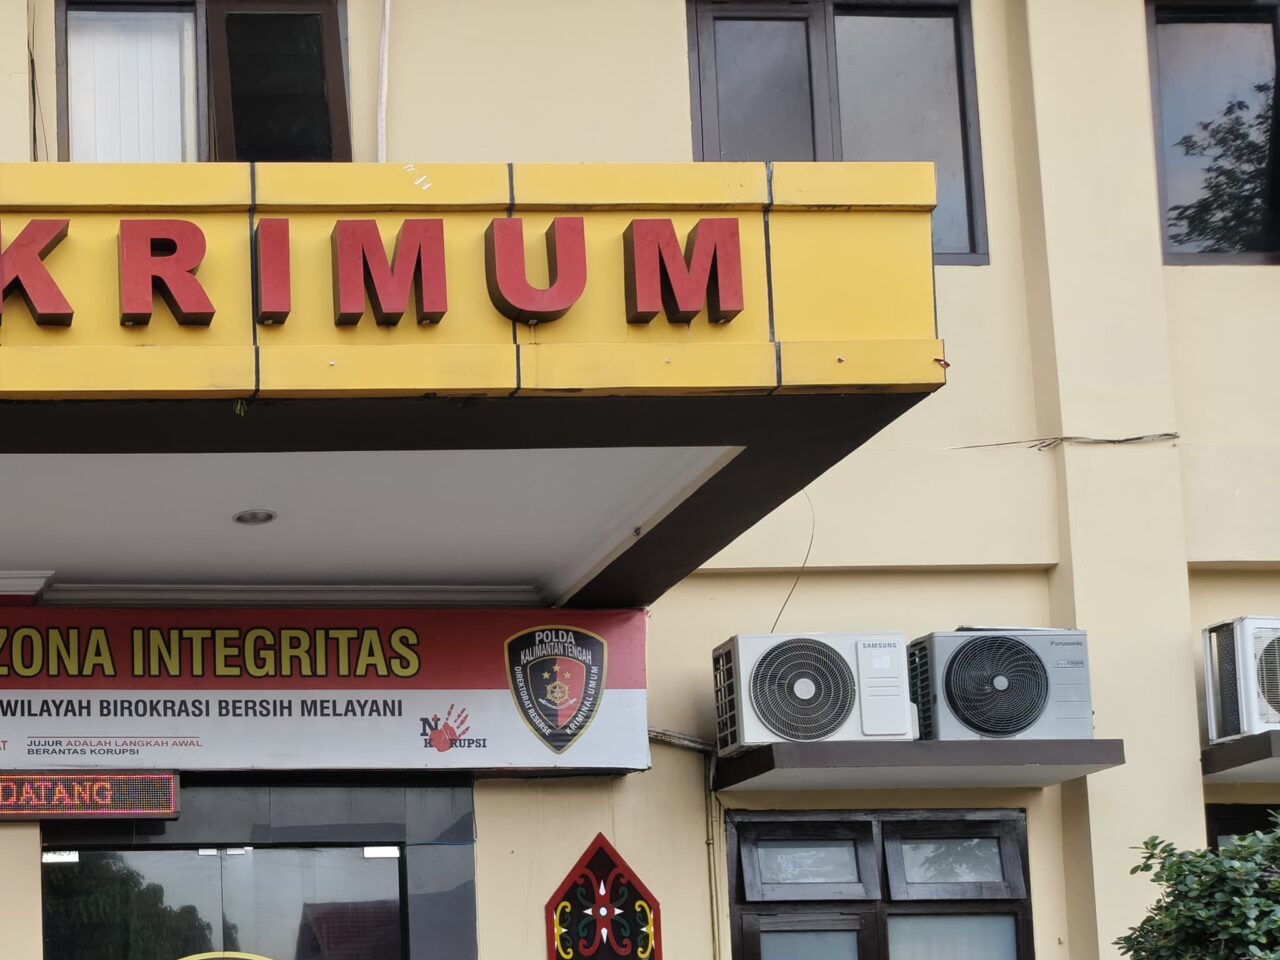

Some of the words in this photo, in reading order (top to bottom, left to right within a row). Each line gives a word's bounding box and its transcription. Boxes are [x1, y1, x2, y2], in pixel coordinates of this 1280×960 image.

[535, 630, 576, 645] POLDA
[131, 626, 421, 678] INTEGRITAS
[520, 642, 564, 665] KALIMANTAN
[565, 643, 592, 665] TENGAH
[0, 699, 91, 717] WILAYAH
[99, 699, 210, 717] BIROKRASI
[219, 699, 293, 718] BERSIH
[300, 699, 404, 718] MELAYANI
[514, 666, 533, 711] DIREKTORAT
[527, 707, 553, 736] RESERSE
[565, 696, 593, 735] KRIMINAL
[587, 666, 599, 694] UMUM
[423, 738, 487, 748] KRUPSI
